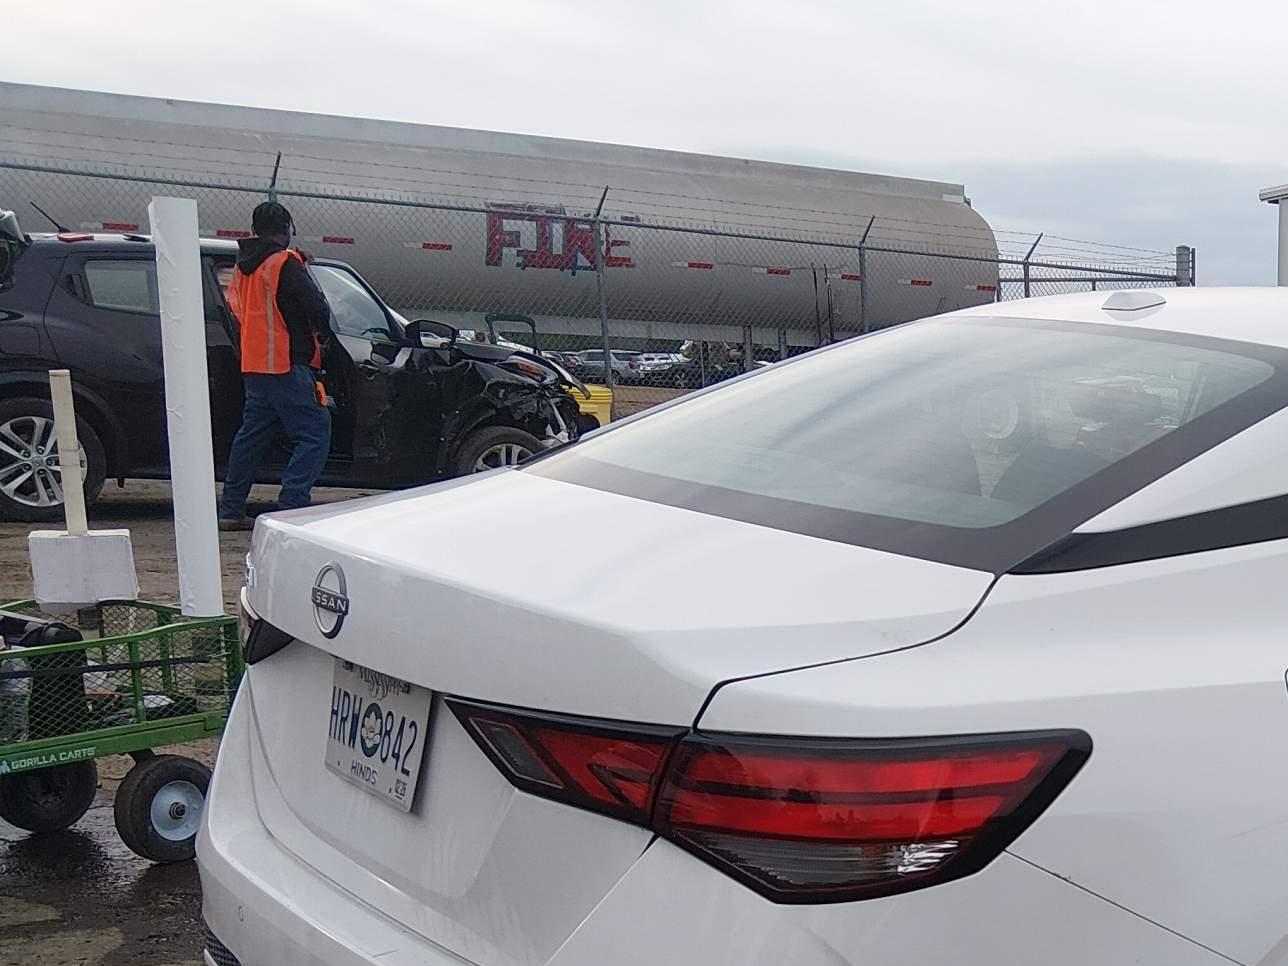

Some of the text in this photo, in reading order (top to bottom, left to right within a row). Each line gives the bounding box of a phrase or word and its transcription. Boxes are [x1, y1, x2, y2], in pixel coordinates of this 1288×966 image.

[329, 686, 418, 777] HRW 842
[11, 747, 96, 770] GORILLA CARTS
[350, 760, 378, 785] HINDS
